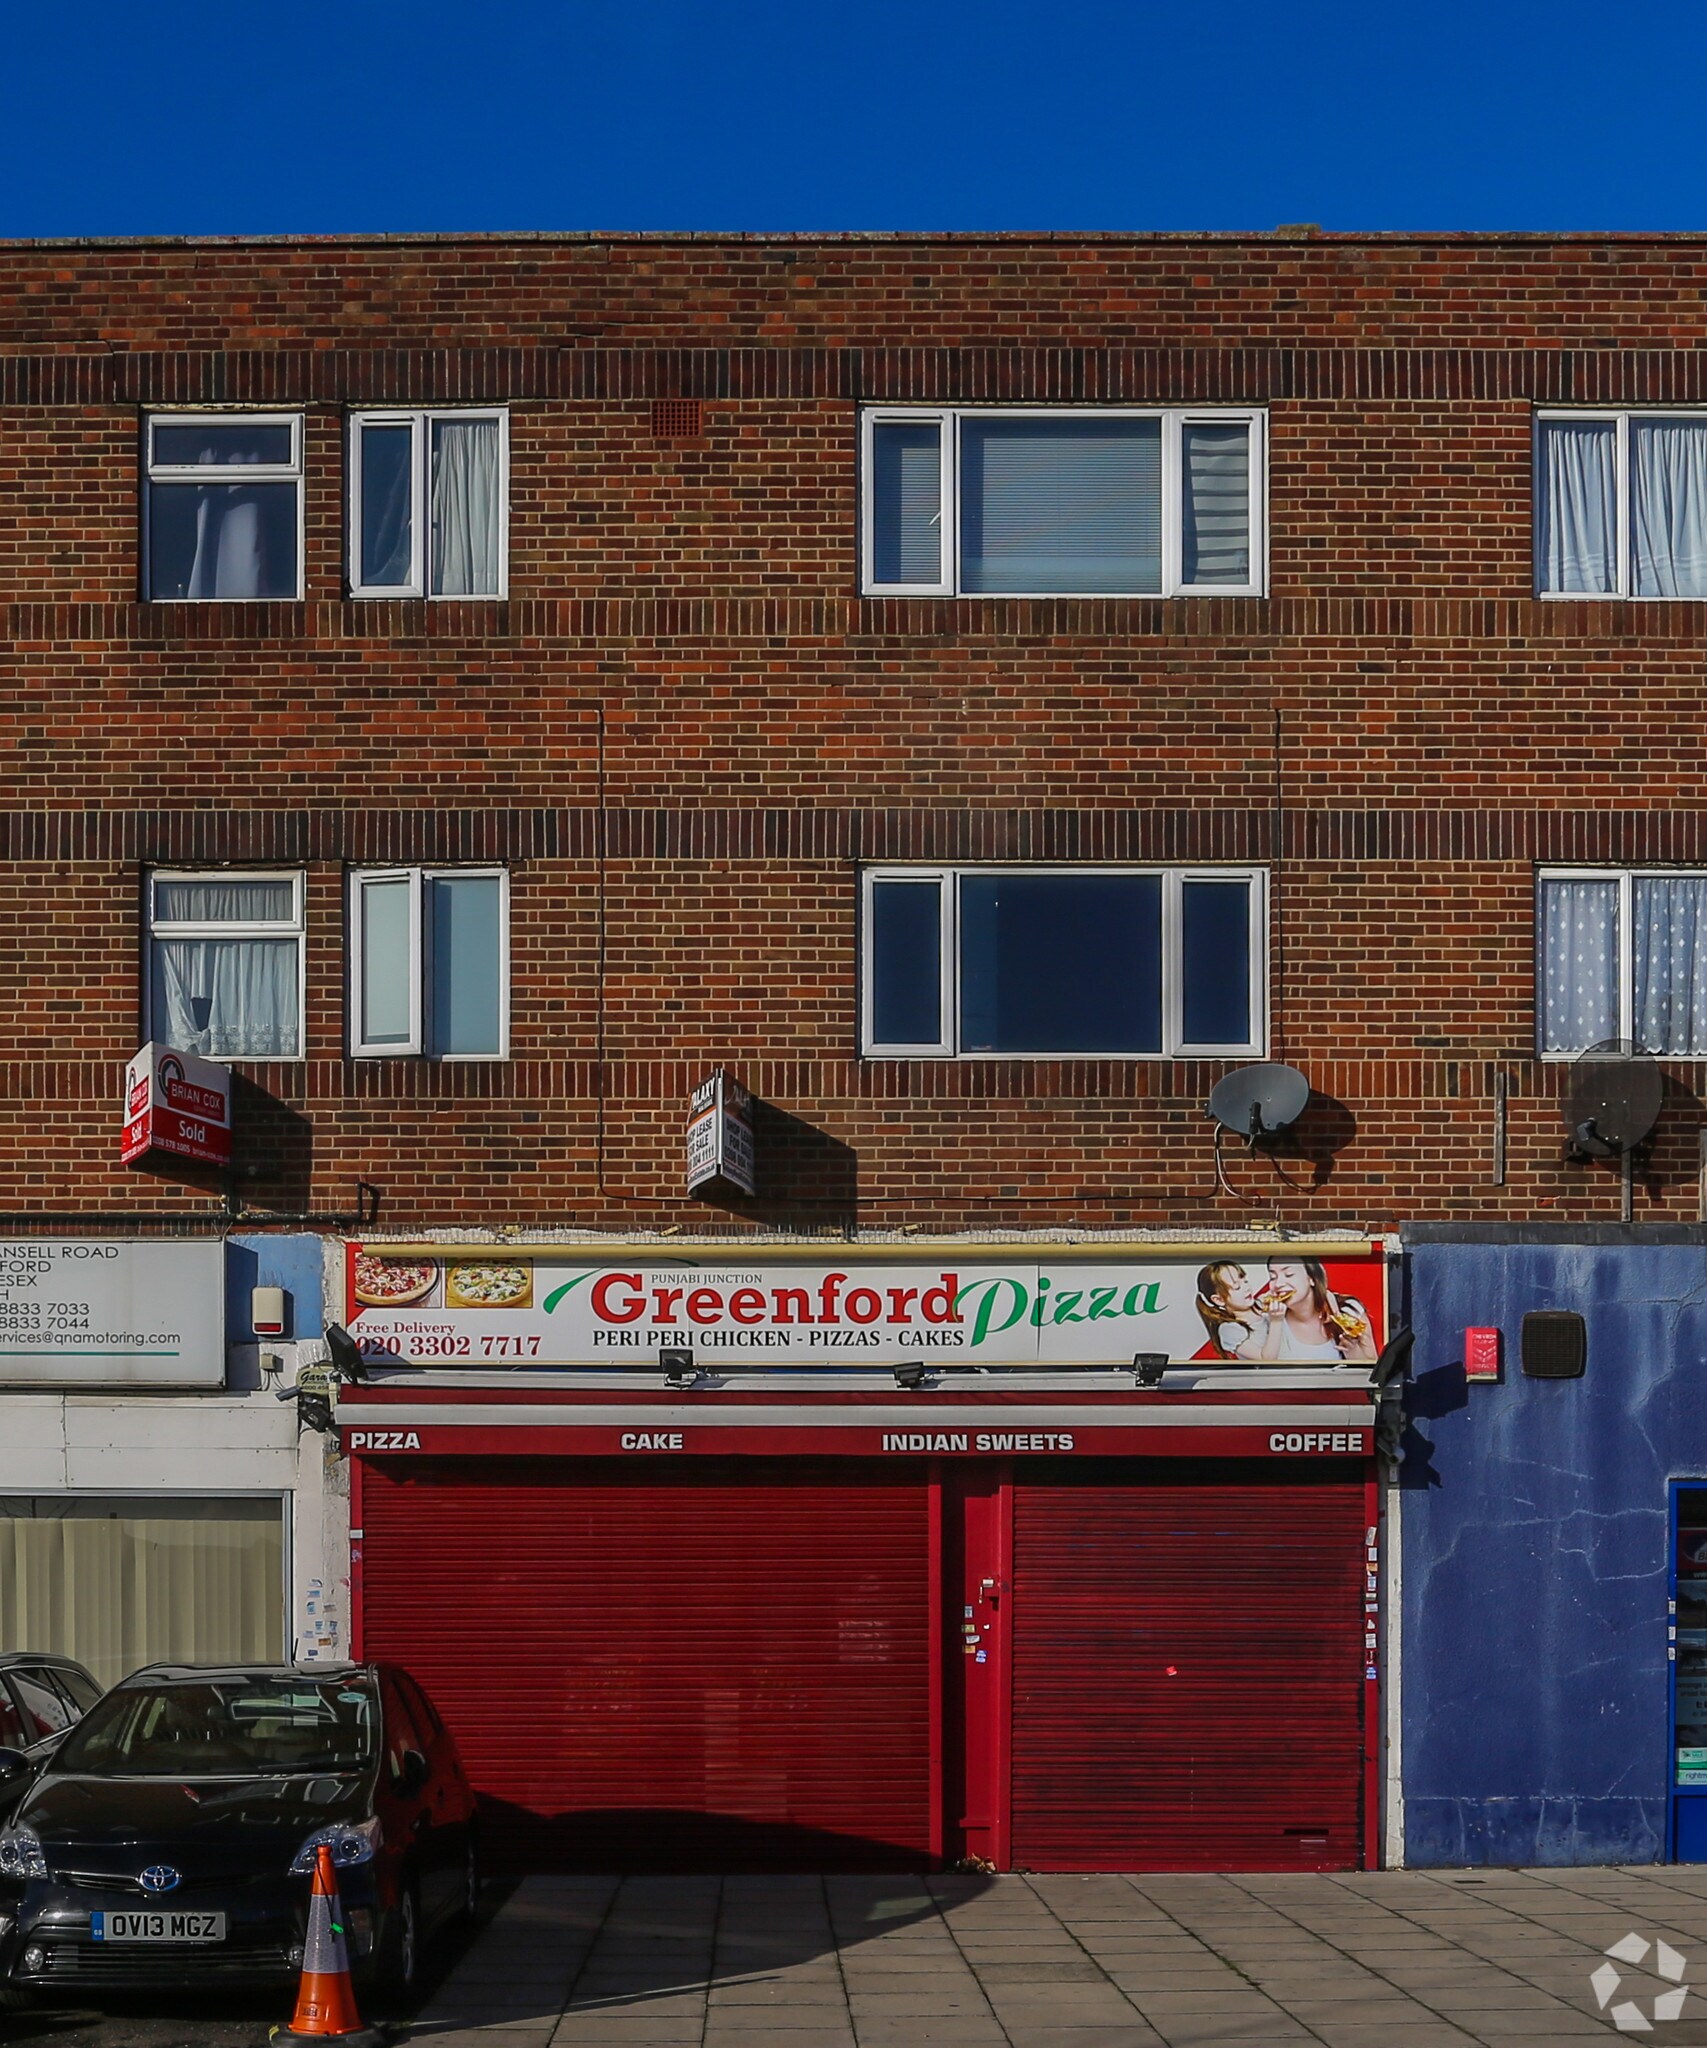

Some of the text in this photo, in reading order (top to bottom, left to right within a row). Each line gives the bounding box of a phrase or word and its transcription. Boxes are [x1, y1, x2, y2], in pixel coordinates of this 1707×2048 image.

[171, 1083, 200, 1104] BRIAN
[203, 1092, 220, 1110] COX
[178, 1120, 205, 1143] Sold
[696, 1117, 712, 1137] LEASE
[62, 1246, 119, 1259] ROAD
[0, 1261, 51, 1273] FORD
[651, 1274, 762, 1285] PUNJABI JUNCTION
[0, 1303, 90, 1315] 8833 7033
[591, 1273, 1169, 1348] Greenford Pizza
[0, 1317, 90, 1329] 8833 7044
[356, 1322, 456, 1336] Free Delivery
[355, 1336, 541, 1356] 020 3302 7717
[593, 1331, 640, 1347] PERI
[646, 1331, 694, 1347] PERI
[700, 1331, 791, 1347] CHICKEN
[809, 1331, 880, 1347] PIZZAS
[899, 1331, 964, 1347] CAKES
[350, 1432, 421, 1450] PIZZA
[621, 1432, 683, 1450] CAKE
[881, 1433, 1074, 1452] INDIAN SWEETS
[1269, 1433, 1363, 1452] COFFEE
[112, 1915, 217, 1937] OV13 MGZ
